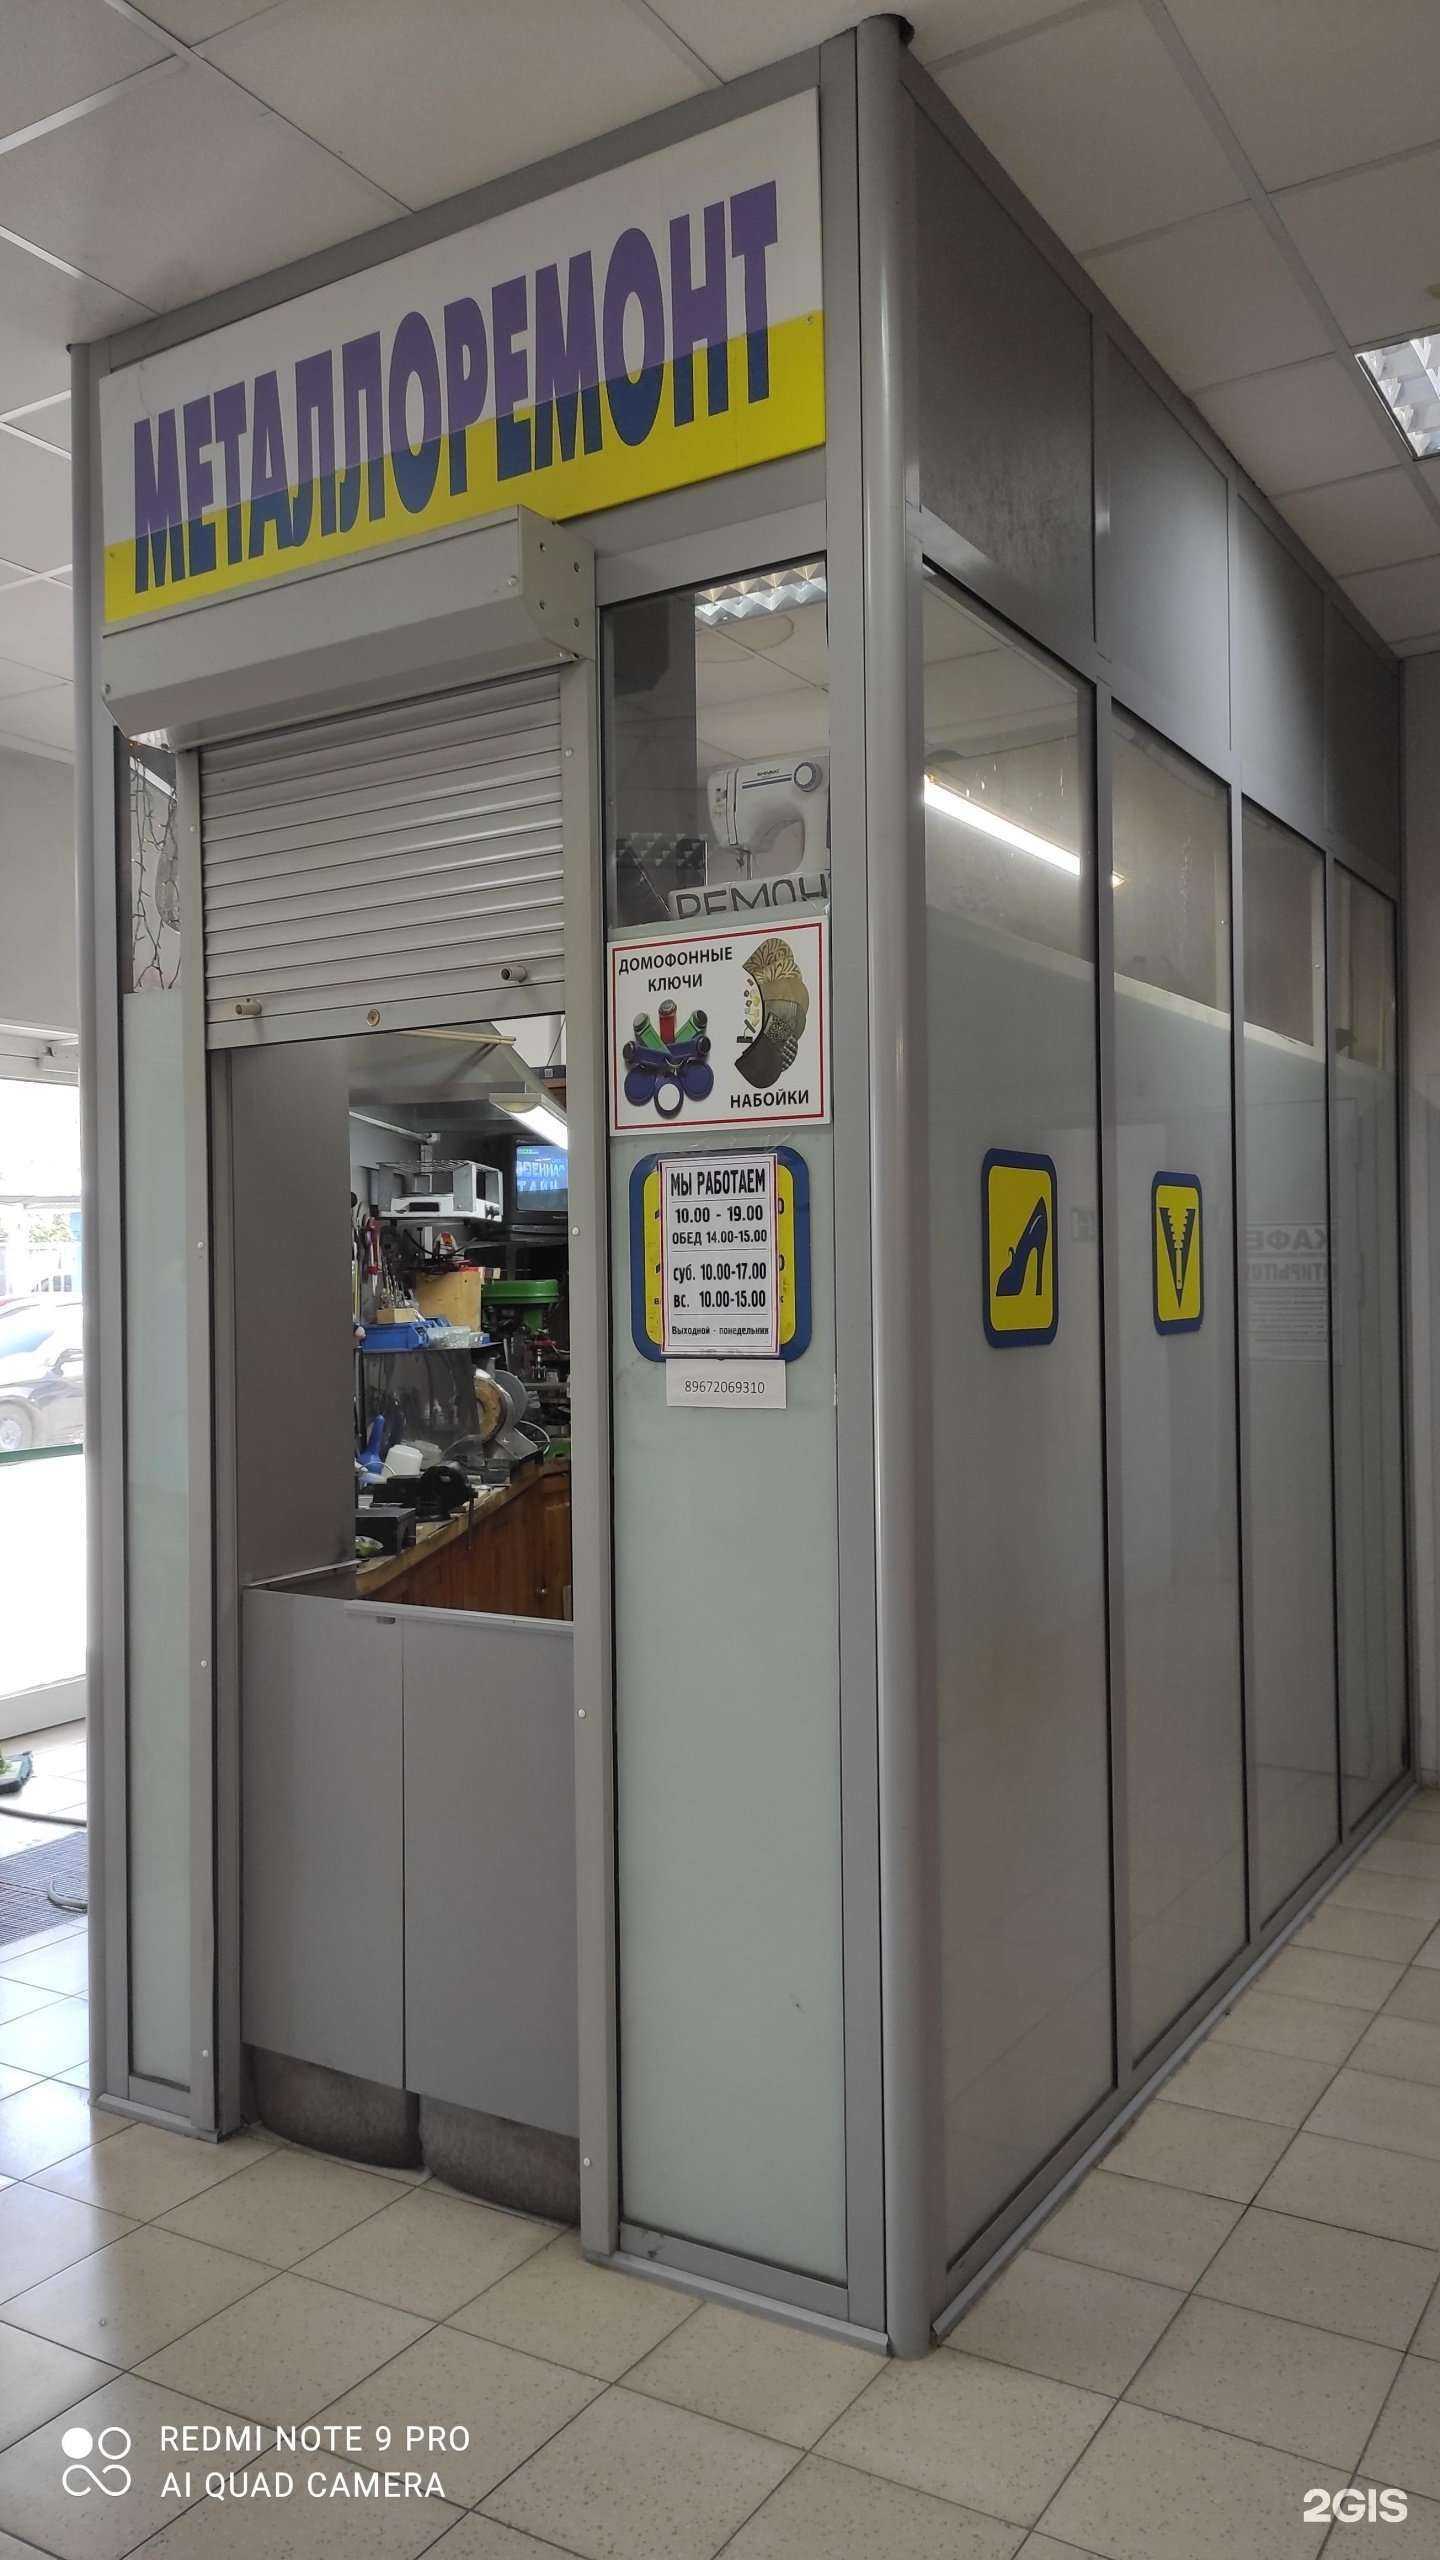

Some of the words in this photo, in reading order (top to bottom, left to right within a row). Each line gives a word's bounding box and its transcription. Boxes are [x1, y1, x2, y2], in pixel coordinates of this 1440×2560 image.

[133, 180, 778, 595] МЕТАЛЛОРЕМОНТ
[618, 946, 733, 975] ДОМОФОННЫЕ
[648, 974, 703, 993] КЛЮЧИ
[730, 1088, 810, 1109] НАБОЙКИ
[670, 1172, 692, 1196] МЫ
[697, 1168, 766, 1195] РАБОТАЕМ
[674, 1207, 711, 1223] 10.00
[727, 1205, 763, 1222] 19.00
[672, 1232, 702, 1246] ОБЕД
[706, 1229, 767, 1244] 14.00-15.00
[700, 1262, 767, 1281] 10.00-17.00
[699, 1290, 766, 1308] 10.00-15.00
[671, 1326, 710, 1336] Выходной
[719, 1326, 769, 1336] понедельник
[684, 1380, 765, 1394] 89672069310
